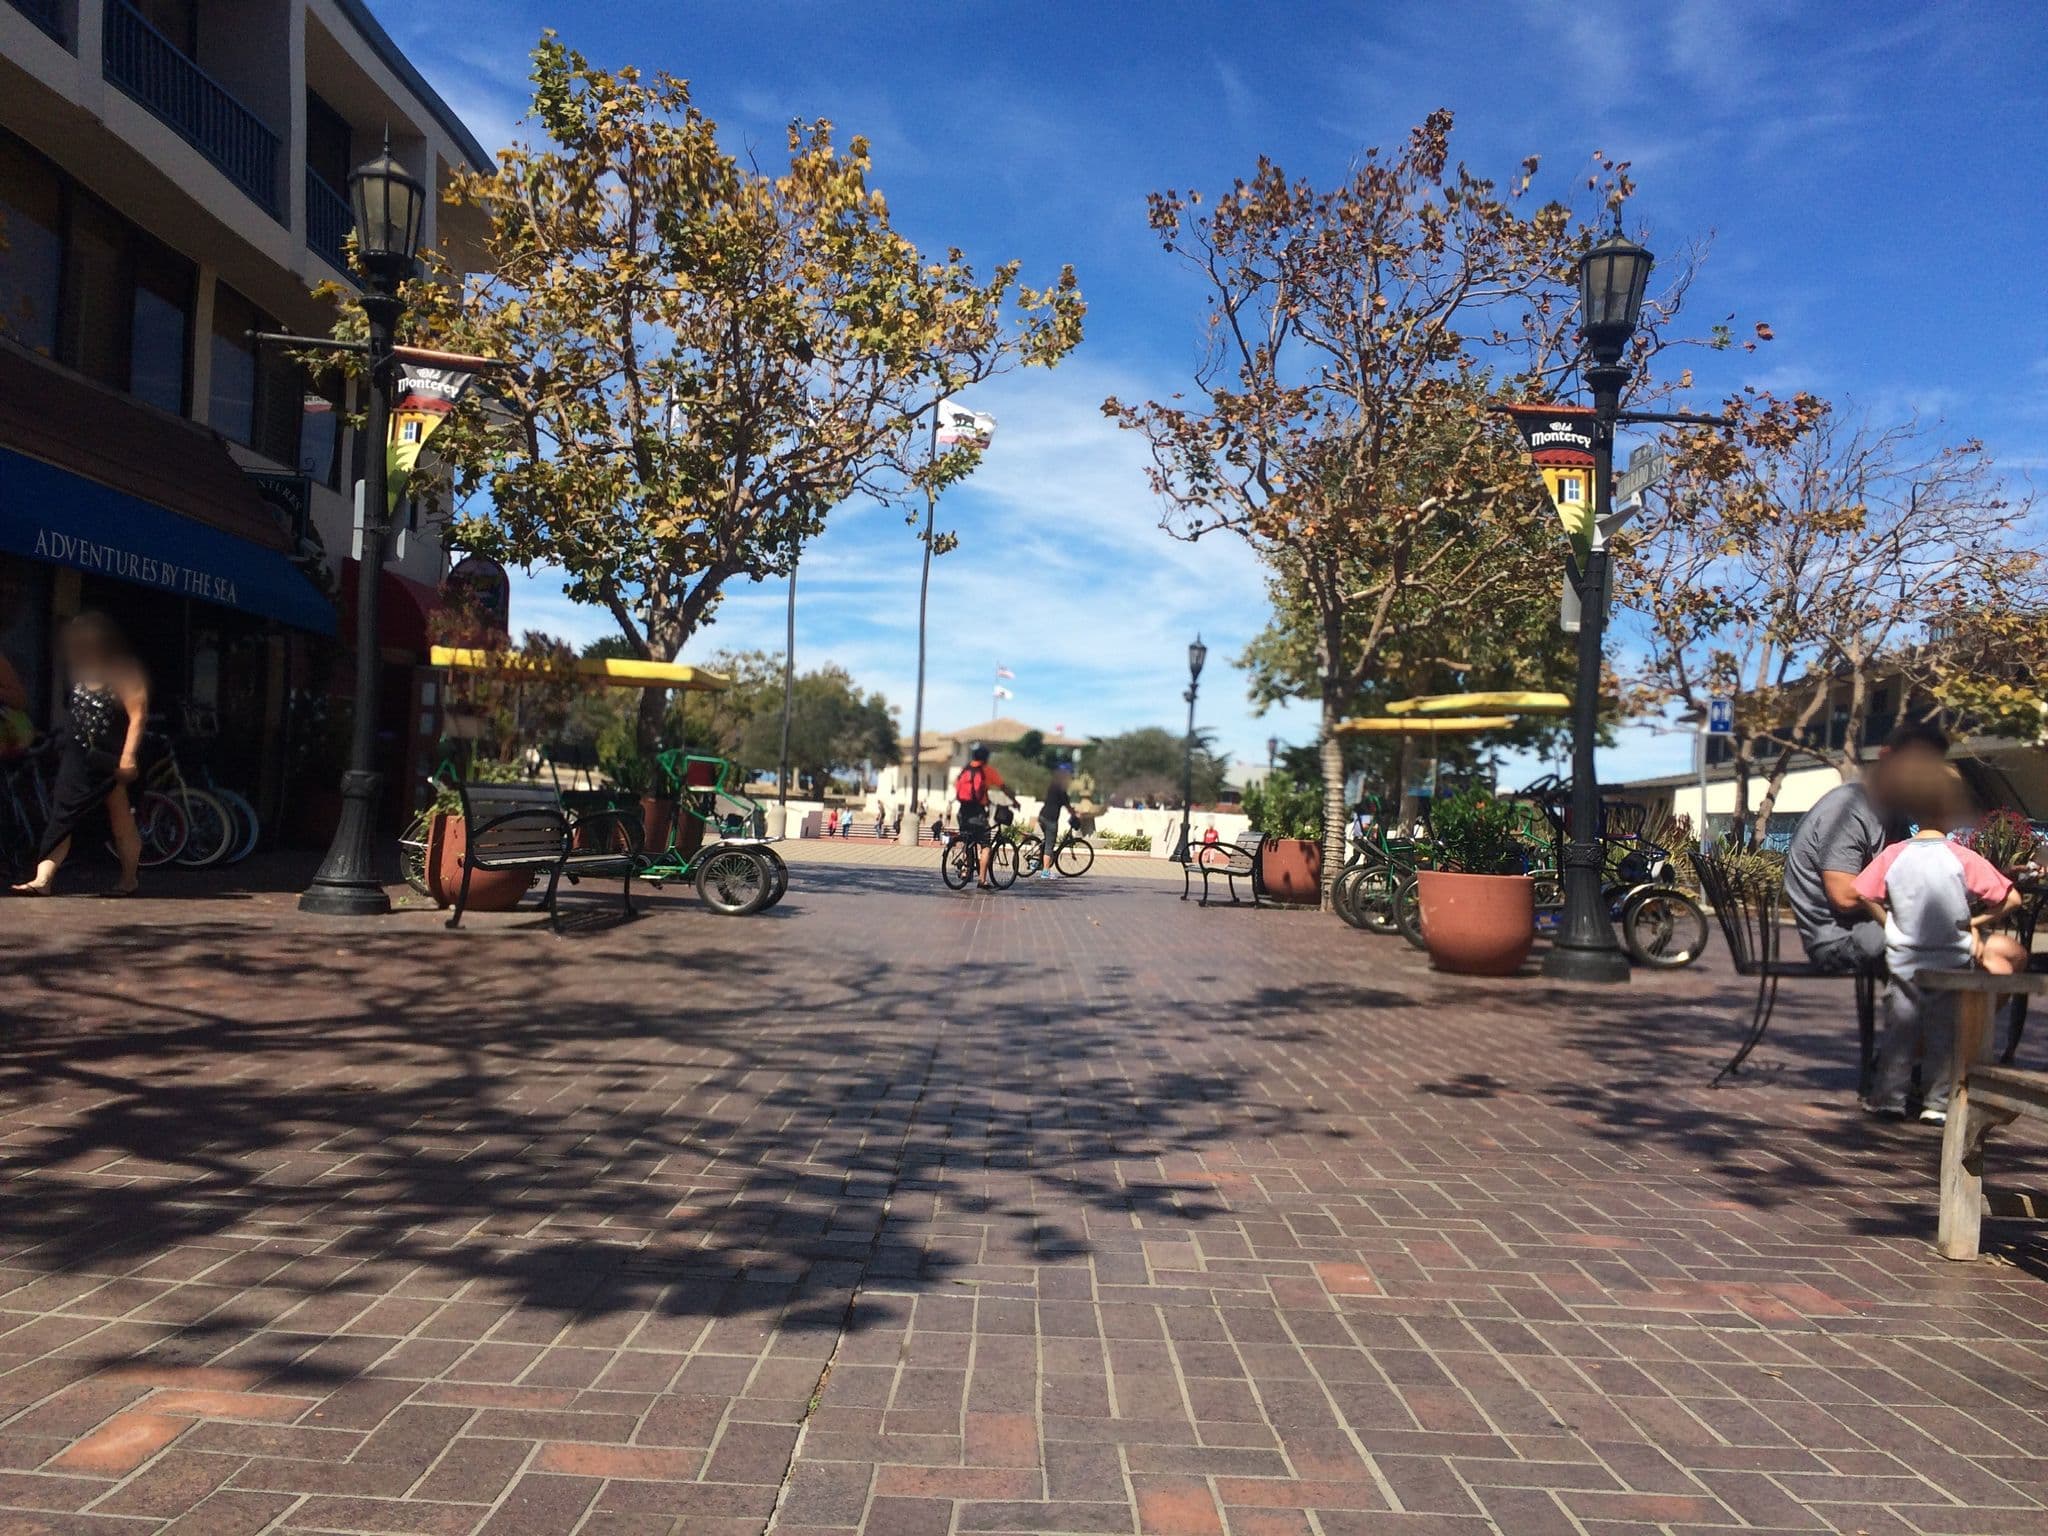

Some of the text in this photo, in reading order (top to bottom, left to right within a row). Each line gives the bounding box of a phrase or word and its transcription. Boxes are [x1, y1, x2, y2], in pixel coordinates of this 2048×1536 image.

[416, 367, 441, 380] Old
[398, 377, 459, 398] Monterey
[1549, 421, 1573, 432] Old
[1531, 431, 1592, 448] Monterey
[34, 528, 237, 604] ADVENTURES BY THE SEA
